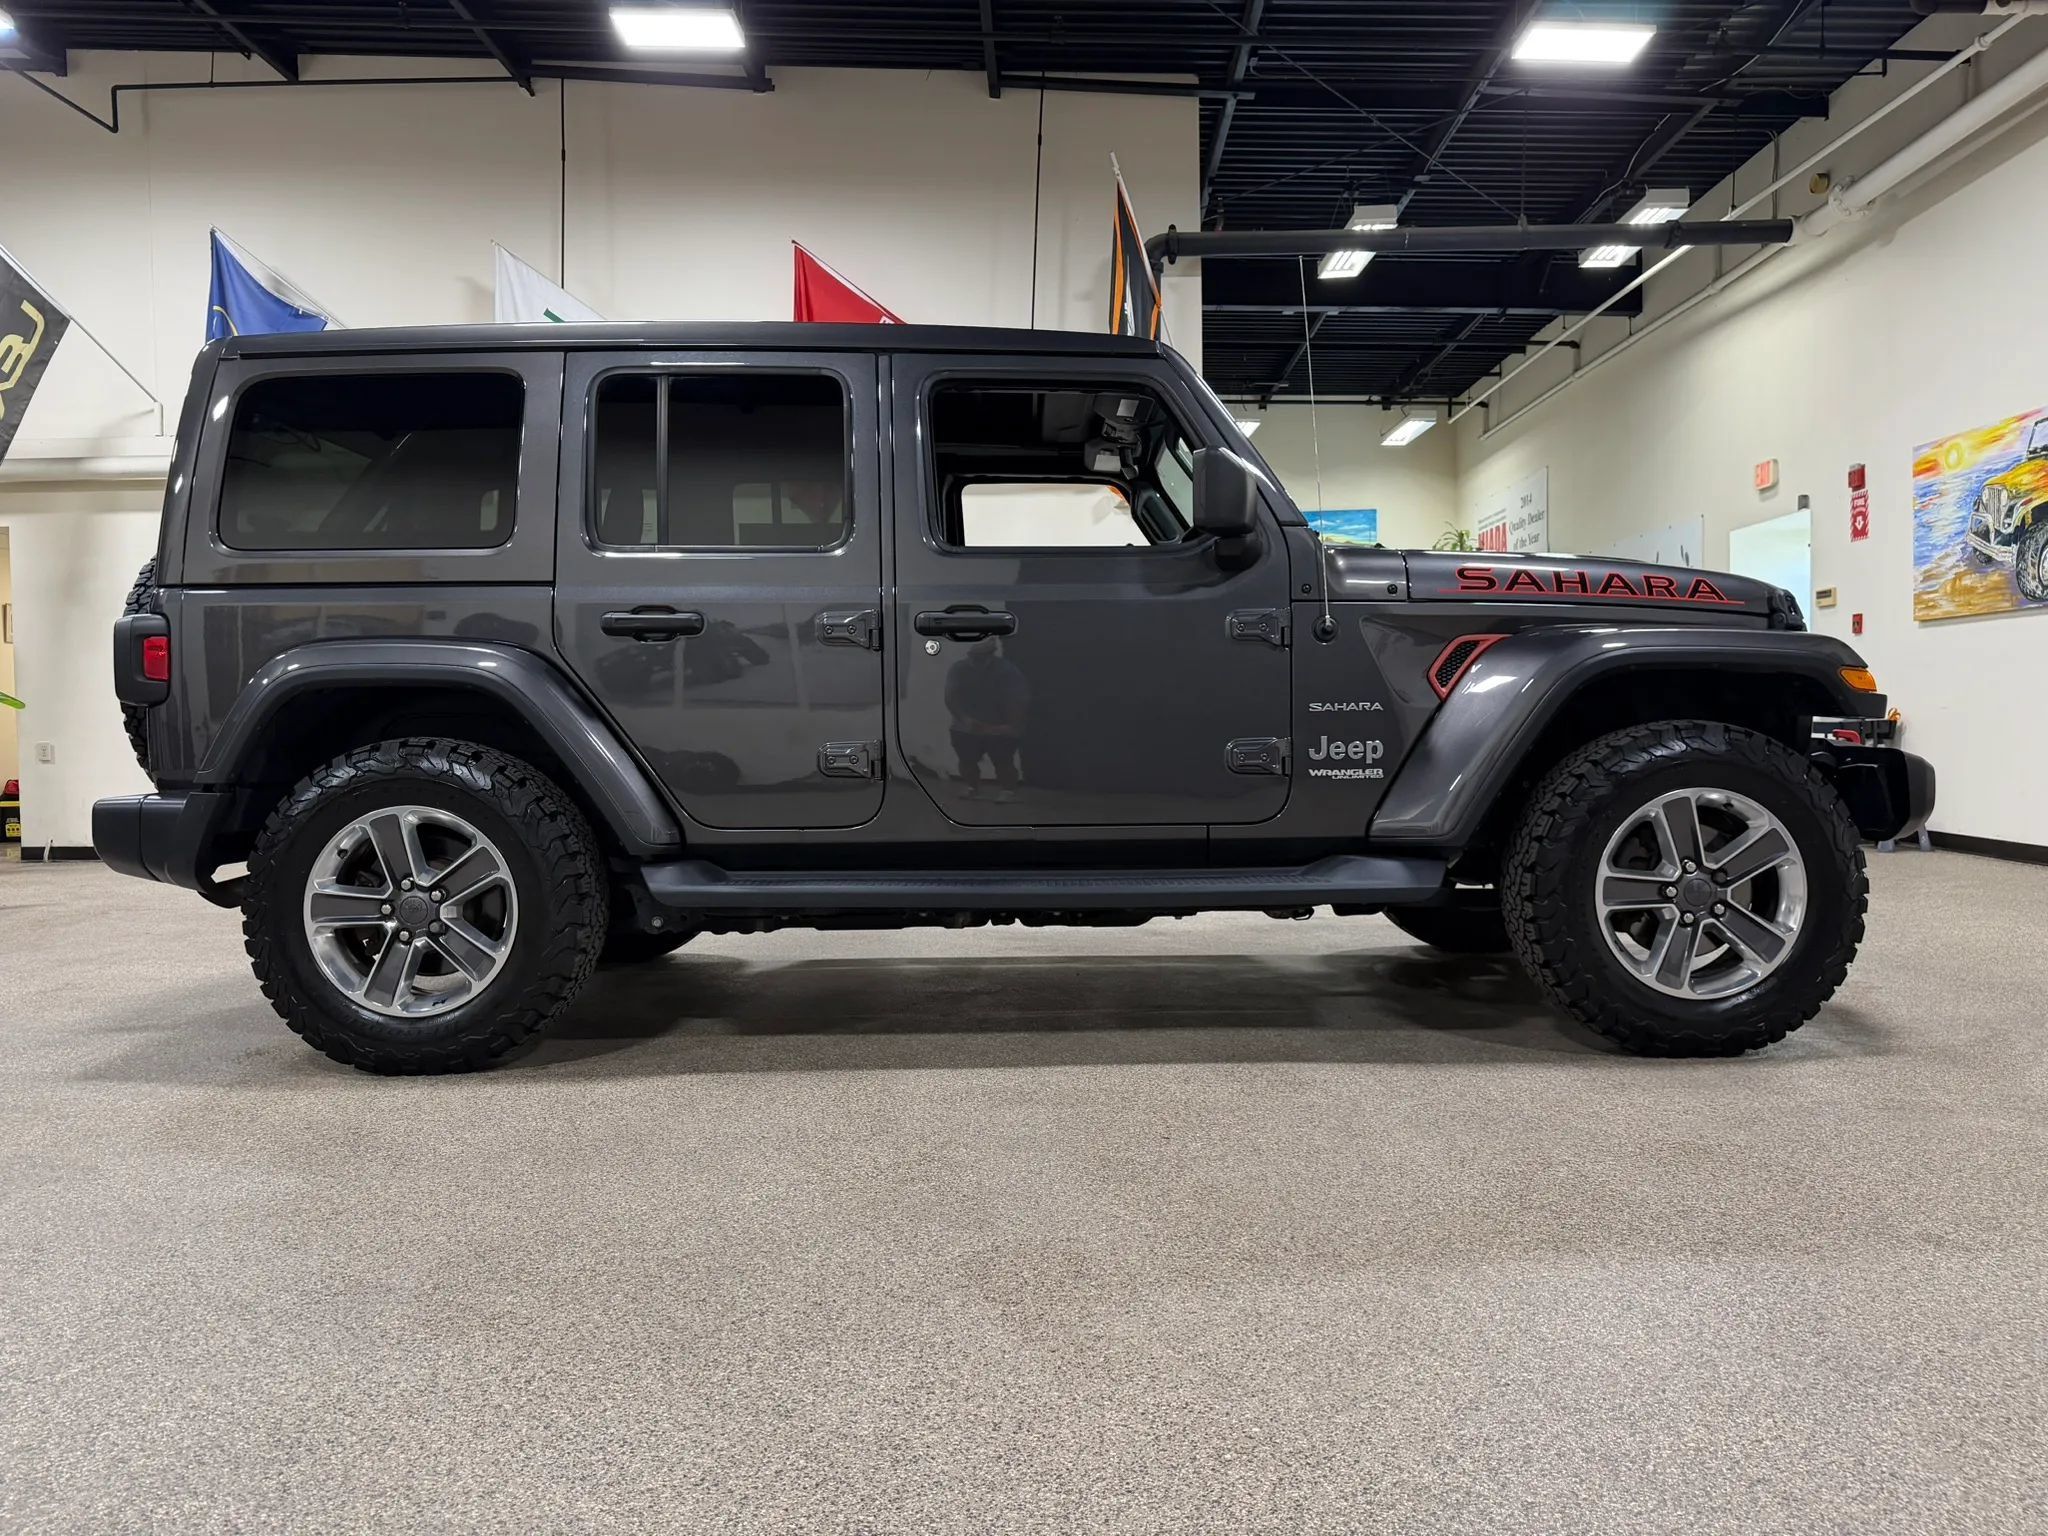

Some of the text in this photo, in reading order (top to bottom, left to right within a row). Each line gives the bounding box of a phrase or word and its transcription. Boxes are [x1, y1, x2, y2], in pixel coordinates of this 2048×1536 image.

[1527, 509, 1545, 526] Dealer
[1456, 567, 1729, 602] SAHARA
[1308, 702, 1384, 711] SAHARA
[1308, 735, 1384, 764] Jeep
[1308, 768, 1384, 776] WRANGLER
